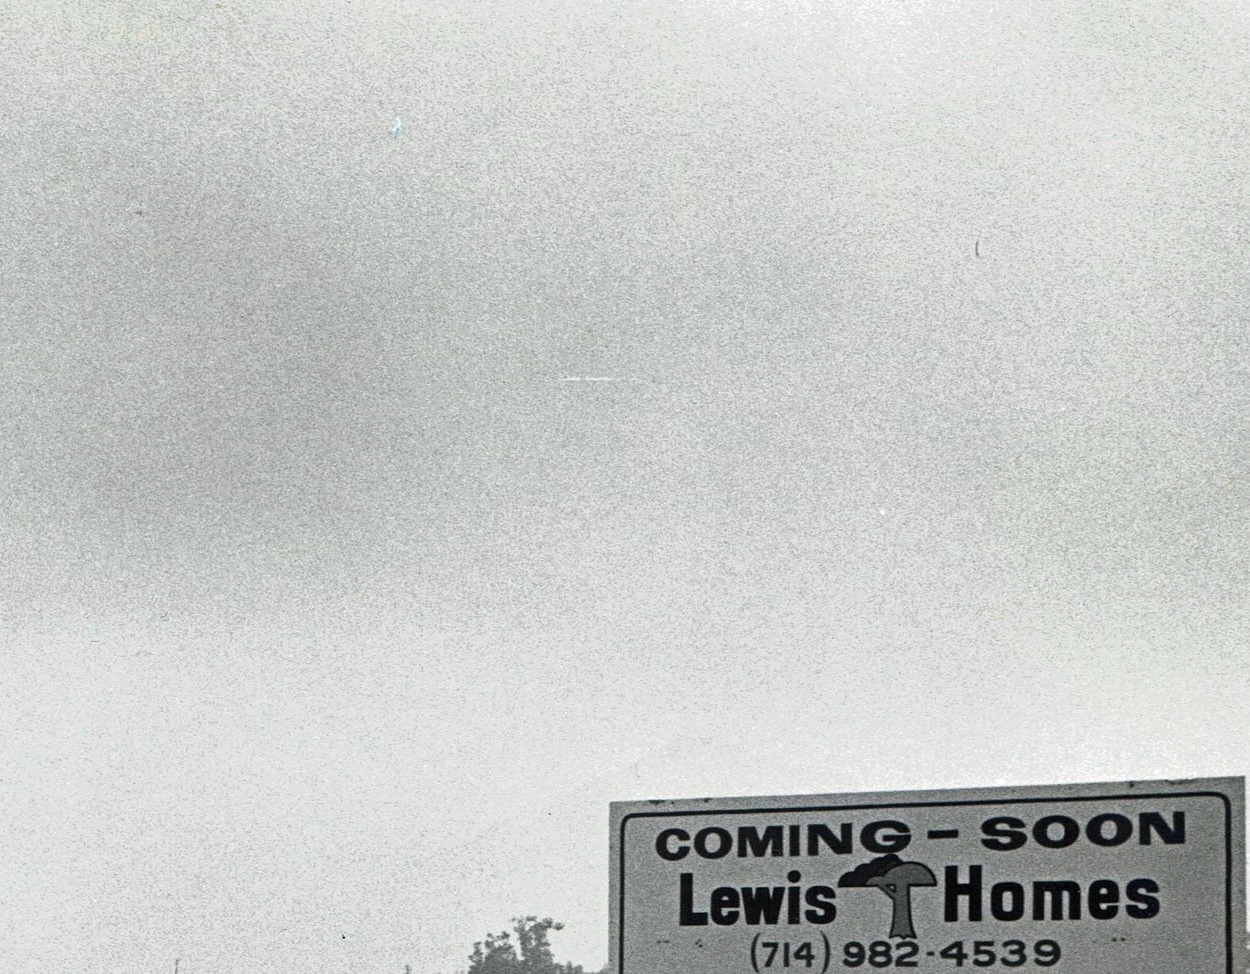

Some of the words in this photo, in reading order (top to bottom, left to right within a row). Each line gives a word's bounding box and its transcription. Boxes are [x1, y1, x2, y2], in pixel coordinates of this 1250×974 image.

[655, 819, 912, 861] COMING
[981, 811, 1185, 851] SOON
[680, 870, 836, 926] Lewis
[944, 865, 1160, 922] Homes
[751, 933, 831, 974] (714)
[842, 938, 1062, 968] 982-4539
